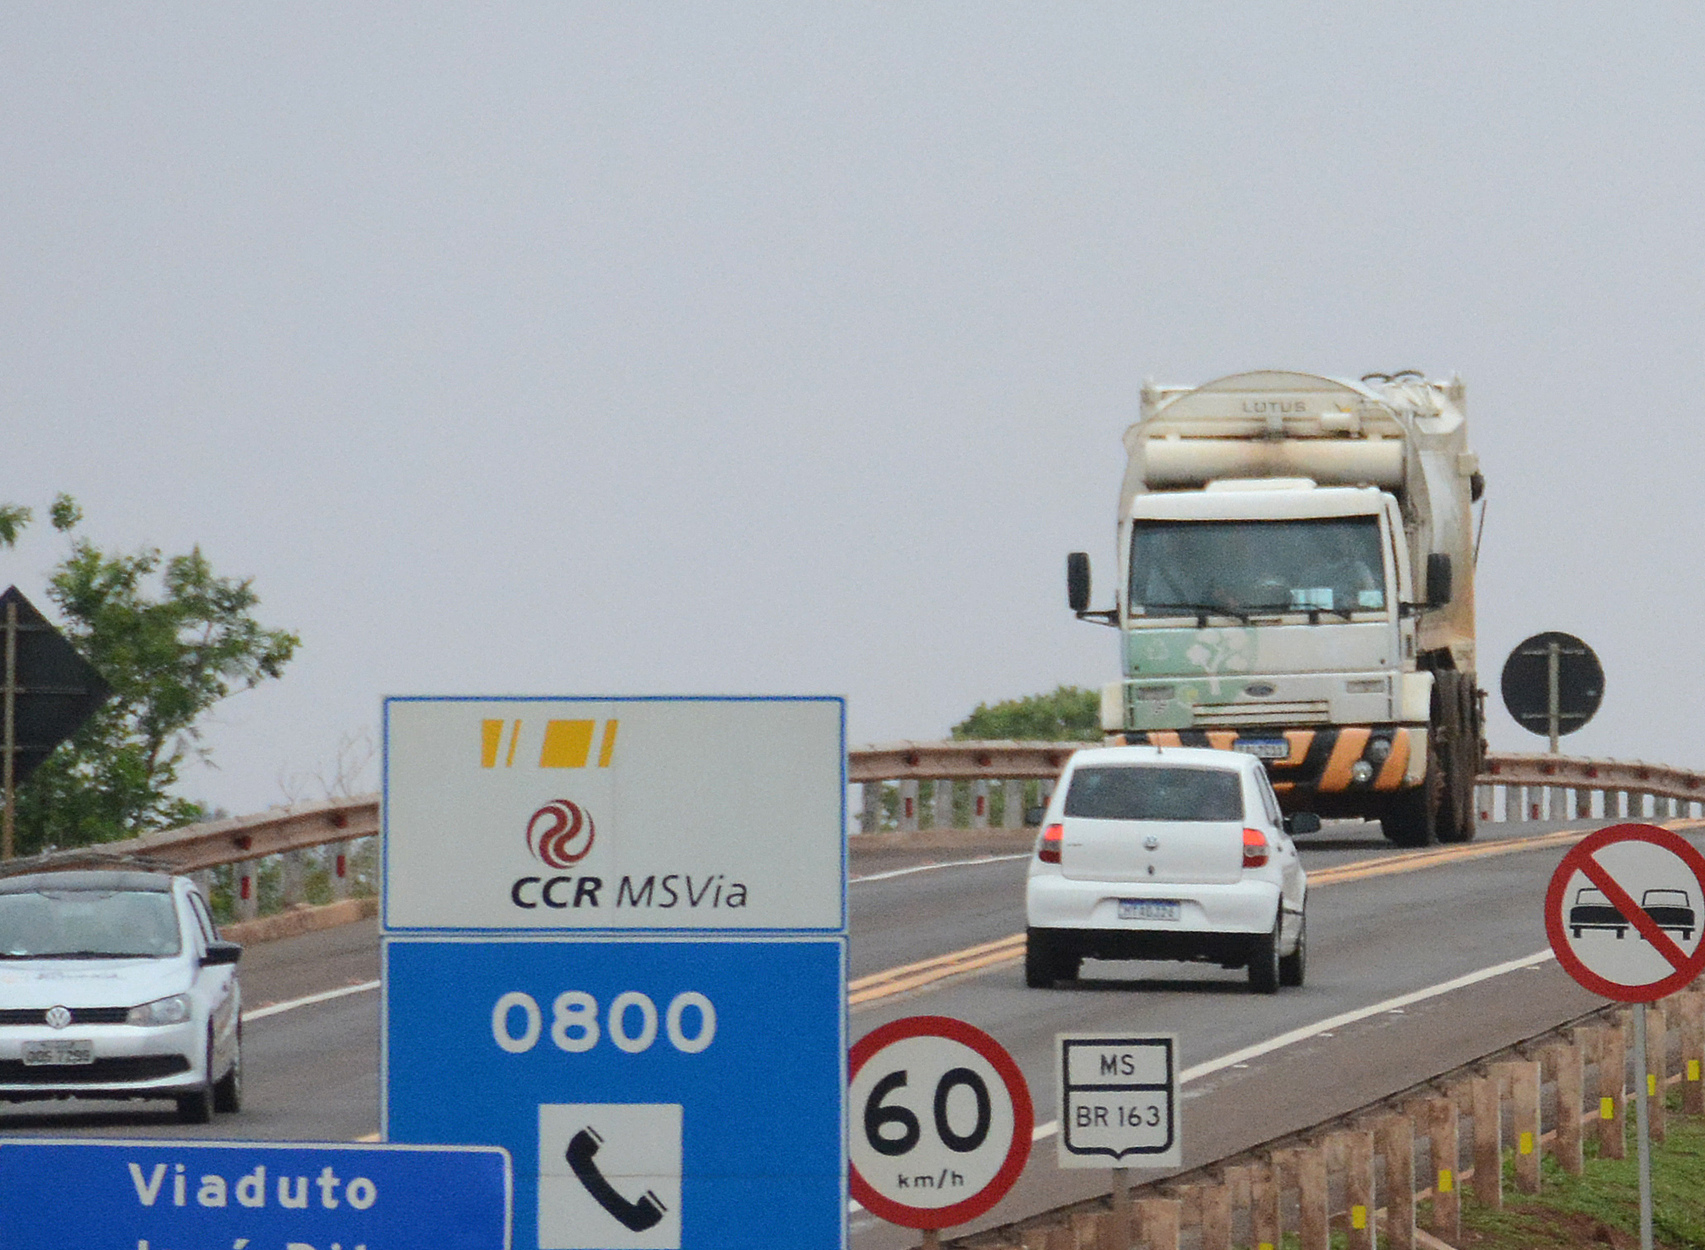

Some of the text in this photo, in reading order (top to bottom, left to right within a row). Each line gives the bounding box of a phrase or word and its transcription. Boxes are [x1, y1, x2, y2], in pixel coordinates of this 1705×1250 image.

[510, 874, 748, 909] CCR MSVia
[491, 989, 718, 1054] 0800
[1100, 1054, 1135, 1076] MS
[863, 1066, 992, 1157] 60
[1076, 1105, 1161, 1128] BR 163
[127, 1161, 378, 1210] Viaduto
[898, 1168, 965, 1190] km/h
